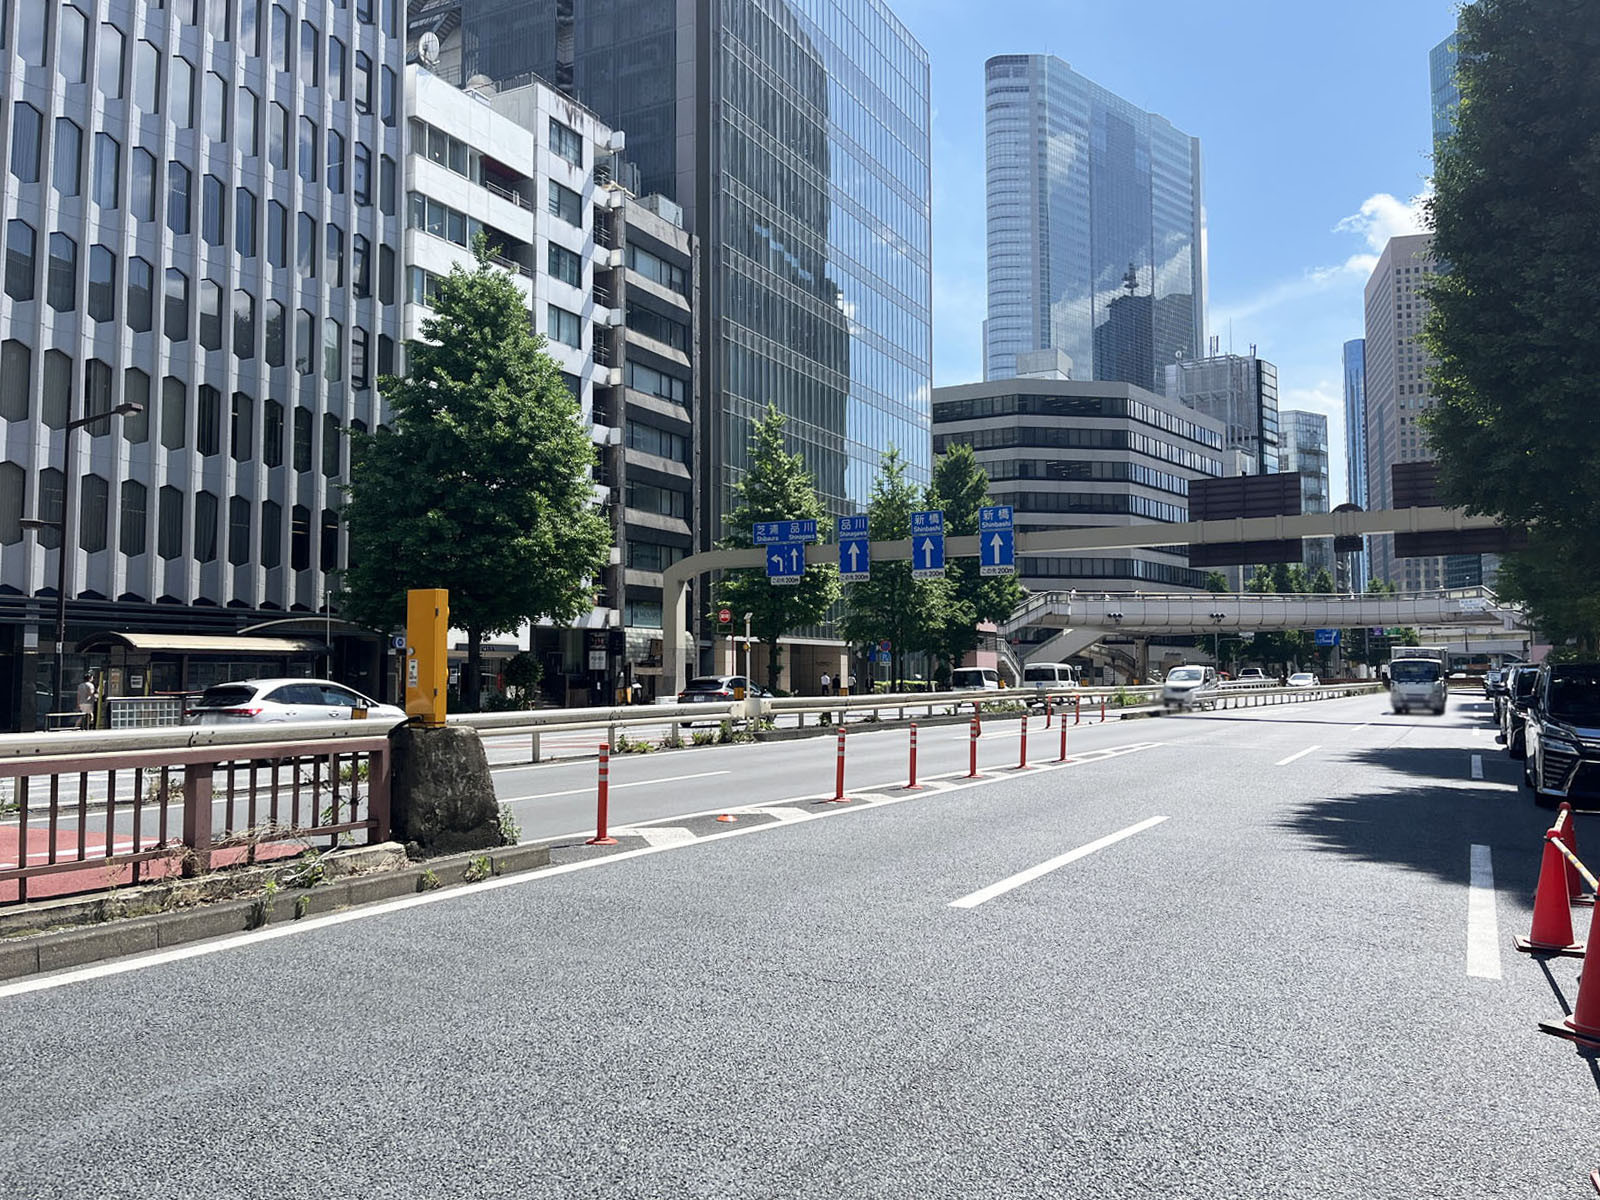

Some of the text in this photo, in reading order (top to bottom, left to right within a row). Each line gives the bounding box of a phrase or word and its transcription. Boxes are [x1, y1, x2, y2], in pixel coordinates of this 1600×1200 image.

[983, 508, 1009, 520] 新橋
[790, 522, 814, 533] 品川
[841, 519, 865, 530] 品川
